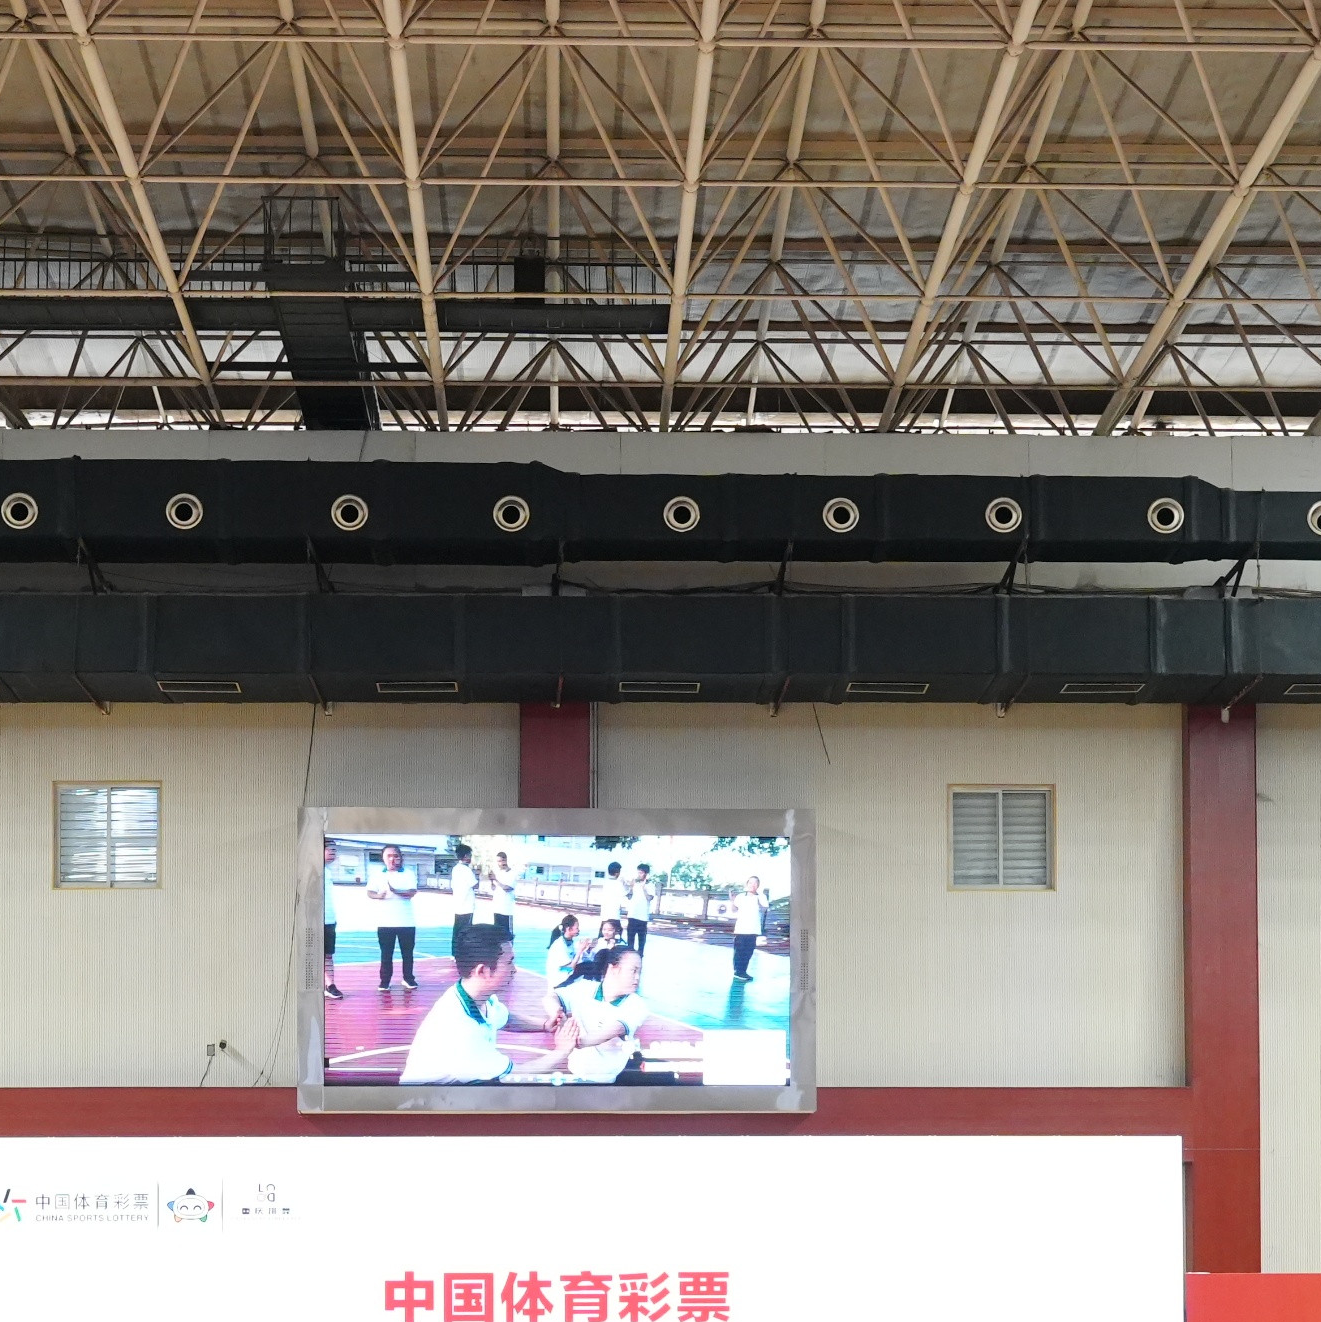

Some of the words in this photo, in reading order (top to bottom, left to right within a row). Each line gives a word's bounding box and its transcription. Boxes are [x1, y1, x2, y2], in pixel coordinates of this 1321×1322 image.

[35, 1193, 149, 1211] 中国体育彩票
[36, 1214, 64, 1222] CHINA
[67, 1214, 104, 1222] SPORTS
[106, 1214, 149, 1222] LOTTERY
